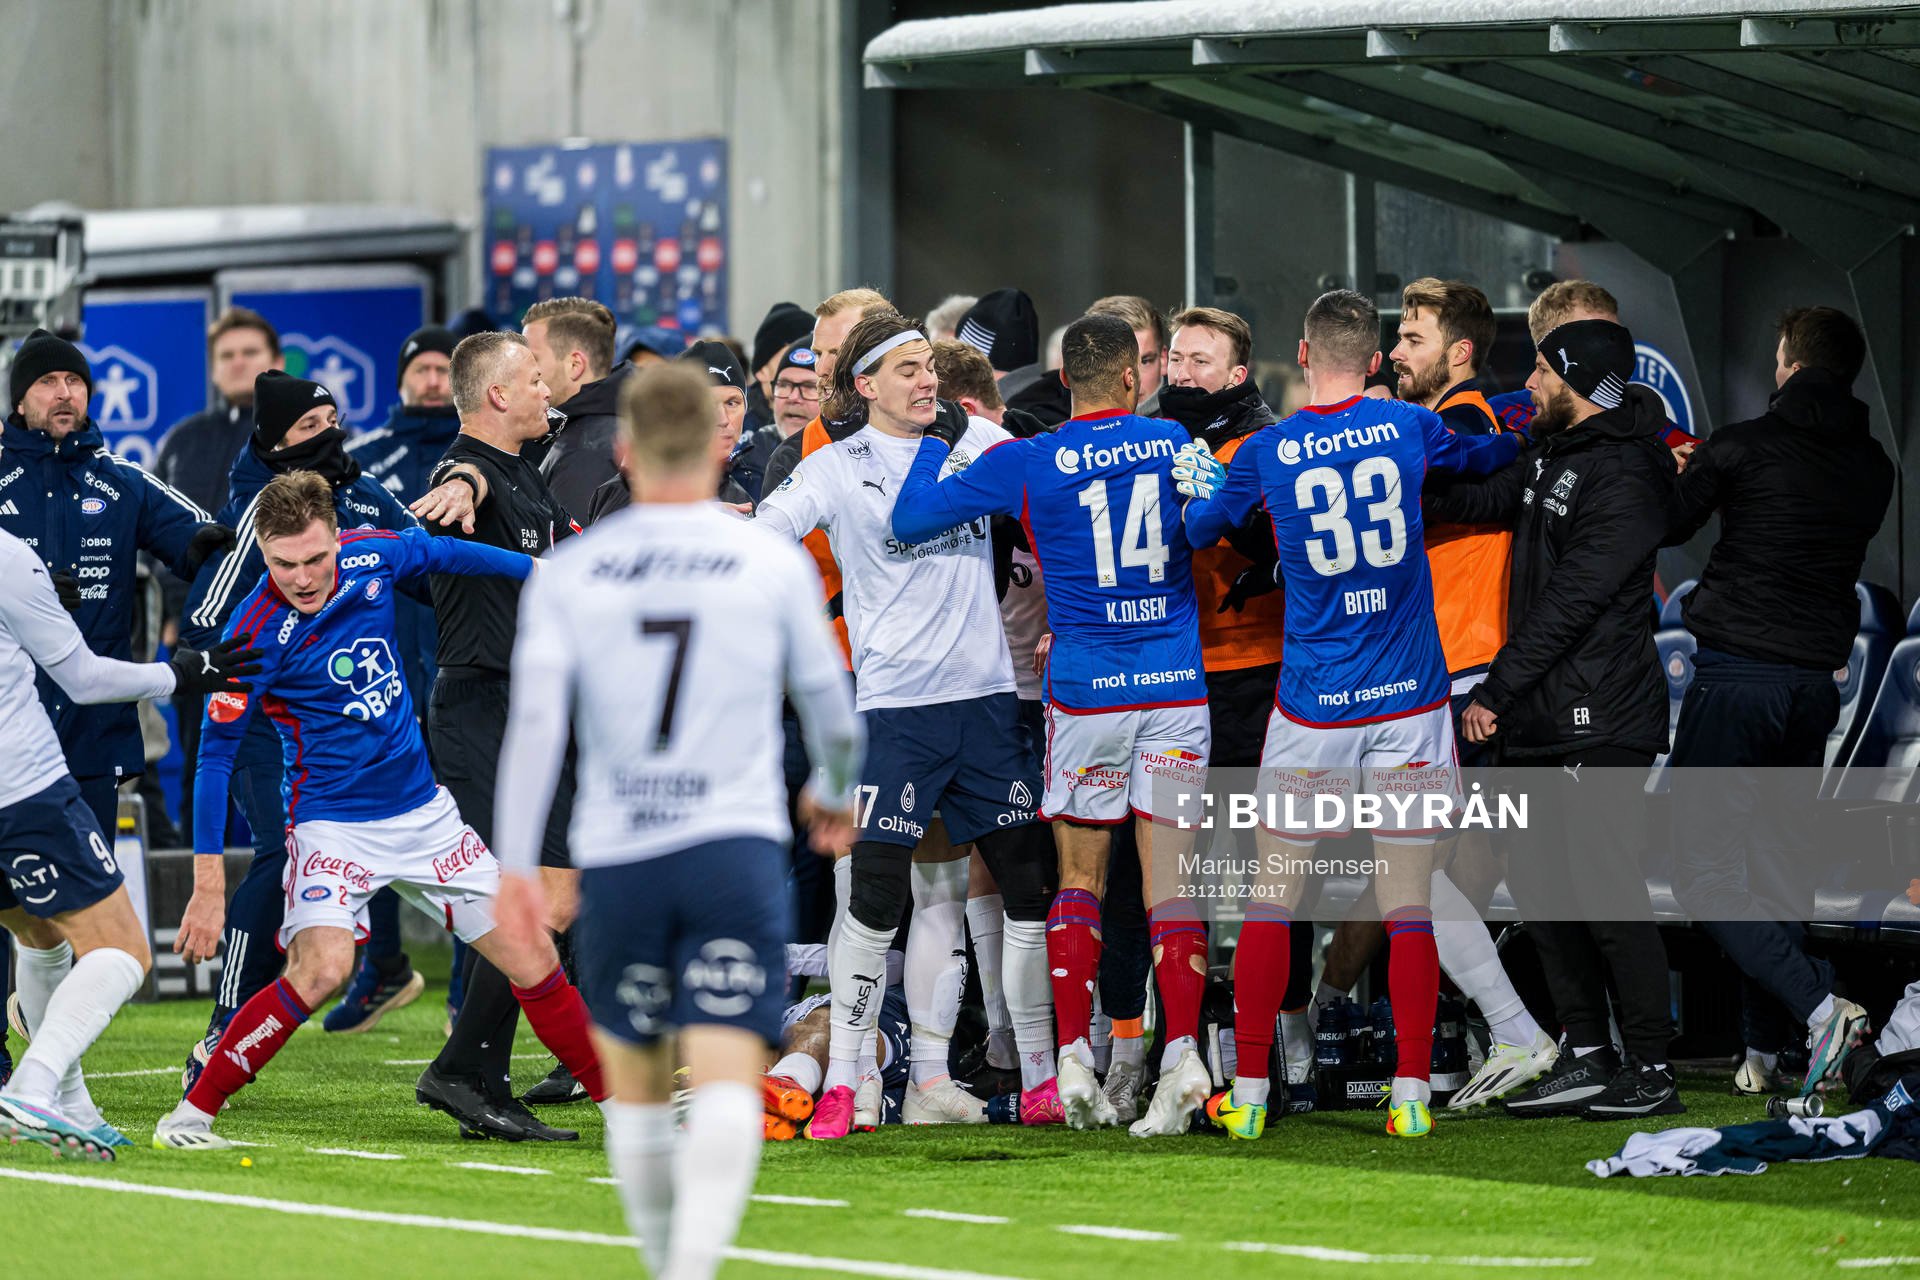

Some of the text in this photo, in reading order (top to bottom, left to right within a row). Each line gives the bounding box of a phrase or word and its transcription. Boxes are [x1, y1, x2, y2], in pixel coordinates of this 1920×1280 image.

[1303, 422, 1400, 459] fortum
[1082, 438, 1176, 471] fortum
[94, 480, 120, 501] OBOS
[353, 503, 380, 516] OBOS
[1294, 455, 1407, 577] 33
[87, 538, 112, 546] OBOS
[521, 528, 538, 539] FAIR
[522, 539, 538, 549] PLAY
[1078, 473, 1170, 588] 14
[80, 553, 112, 562] eamwork.
[341, 553, 380, 570] coop
[911, 534, 972, 562] NORDMØRE
[1105, 596, 1167, 623] K.OLSEN
[1344, 588, 1387, 615] BITRI
[641, 617, 692, 746] 7
[1092, 668, 1197, 690] mot rasisme
[1318, 678, 1418, 706] mot rasisme
[342, 669, 402, 722] OBOS
[1573, 707, 1591, 726] ER
[1372, 769, 1450, 781] HURTIGRUTA
[1376, 781, 1443, 792] CARGLASS
[853, 785, 879, 829] 17
[878, 816, 924, 839] olivita
[88, 831, 116, 875] 9
[9, 863, 60, 891] ALTI
[339, 885, 347, 906] 2
[847, 985, 873, 1026] NEAS
[1538, 1067, 1592, 1097] GORE-TEX
